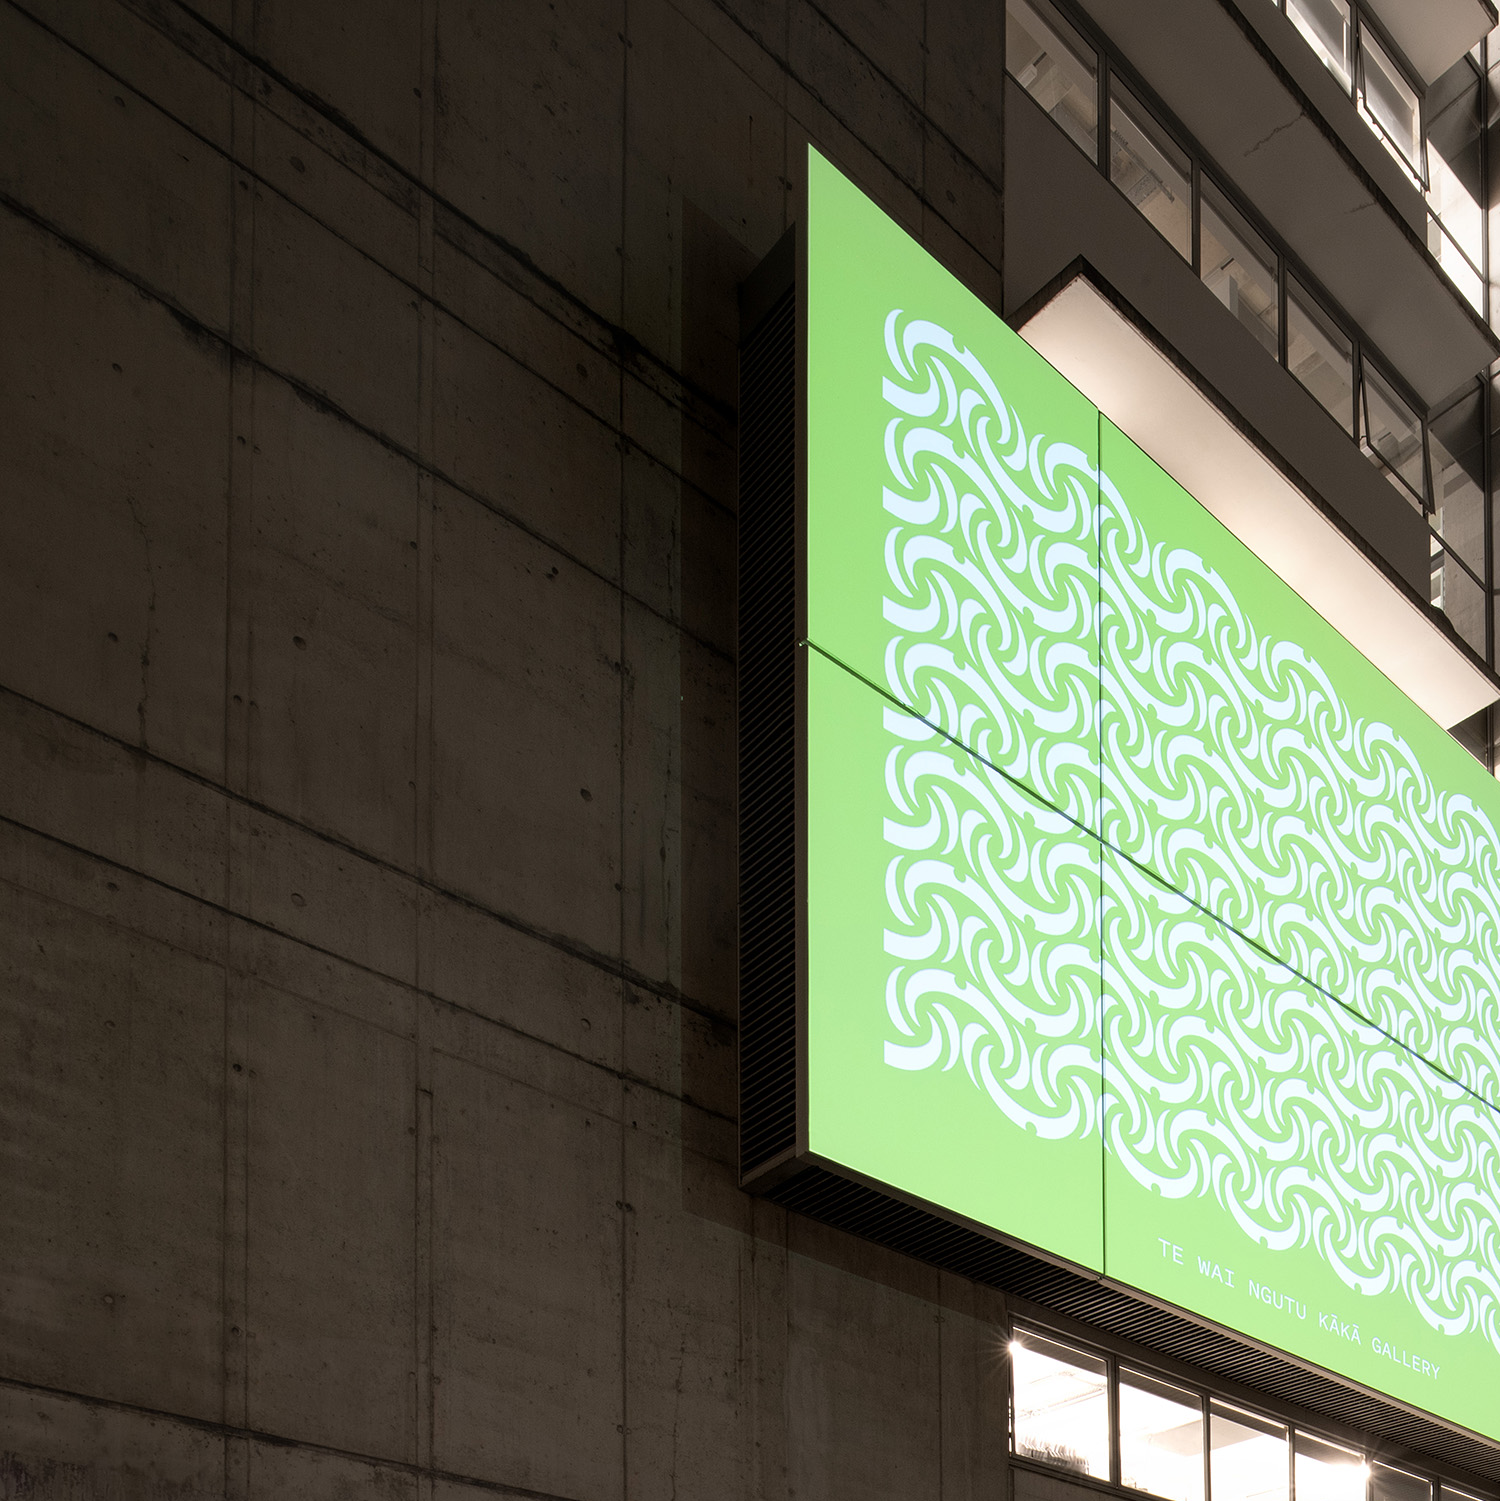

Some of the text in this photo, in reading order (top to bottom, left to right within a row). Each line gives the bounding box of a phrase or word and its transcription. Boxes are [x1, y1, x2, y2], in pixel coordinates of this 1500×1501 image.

[1157, 1237, 1441, 1380] TE WAI NGUTU KĀKĀ GALLERY
